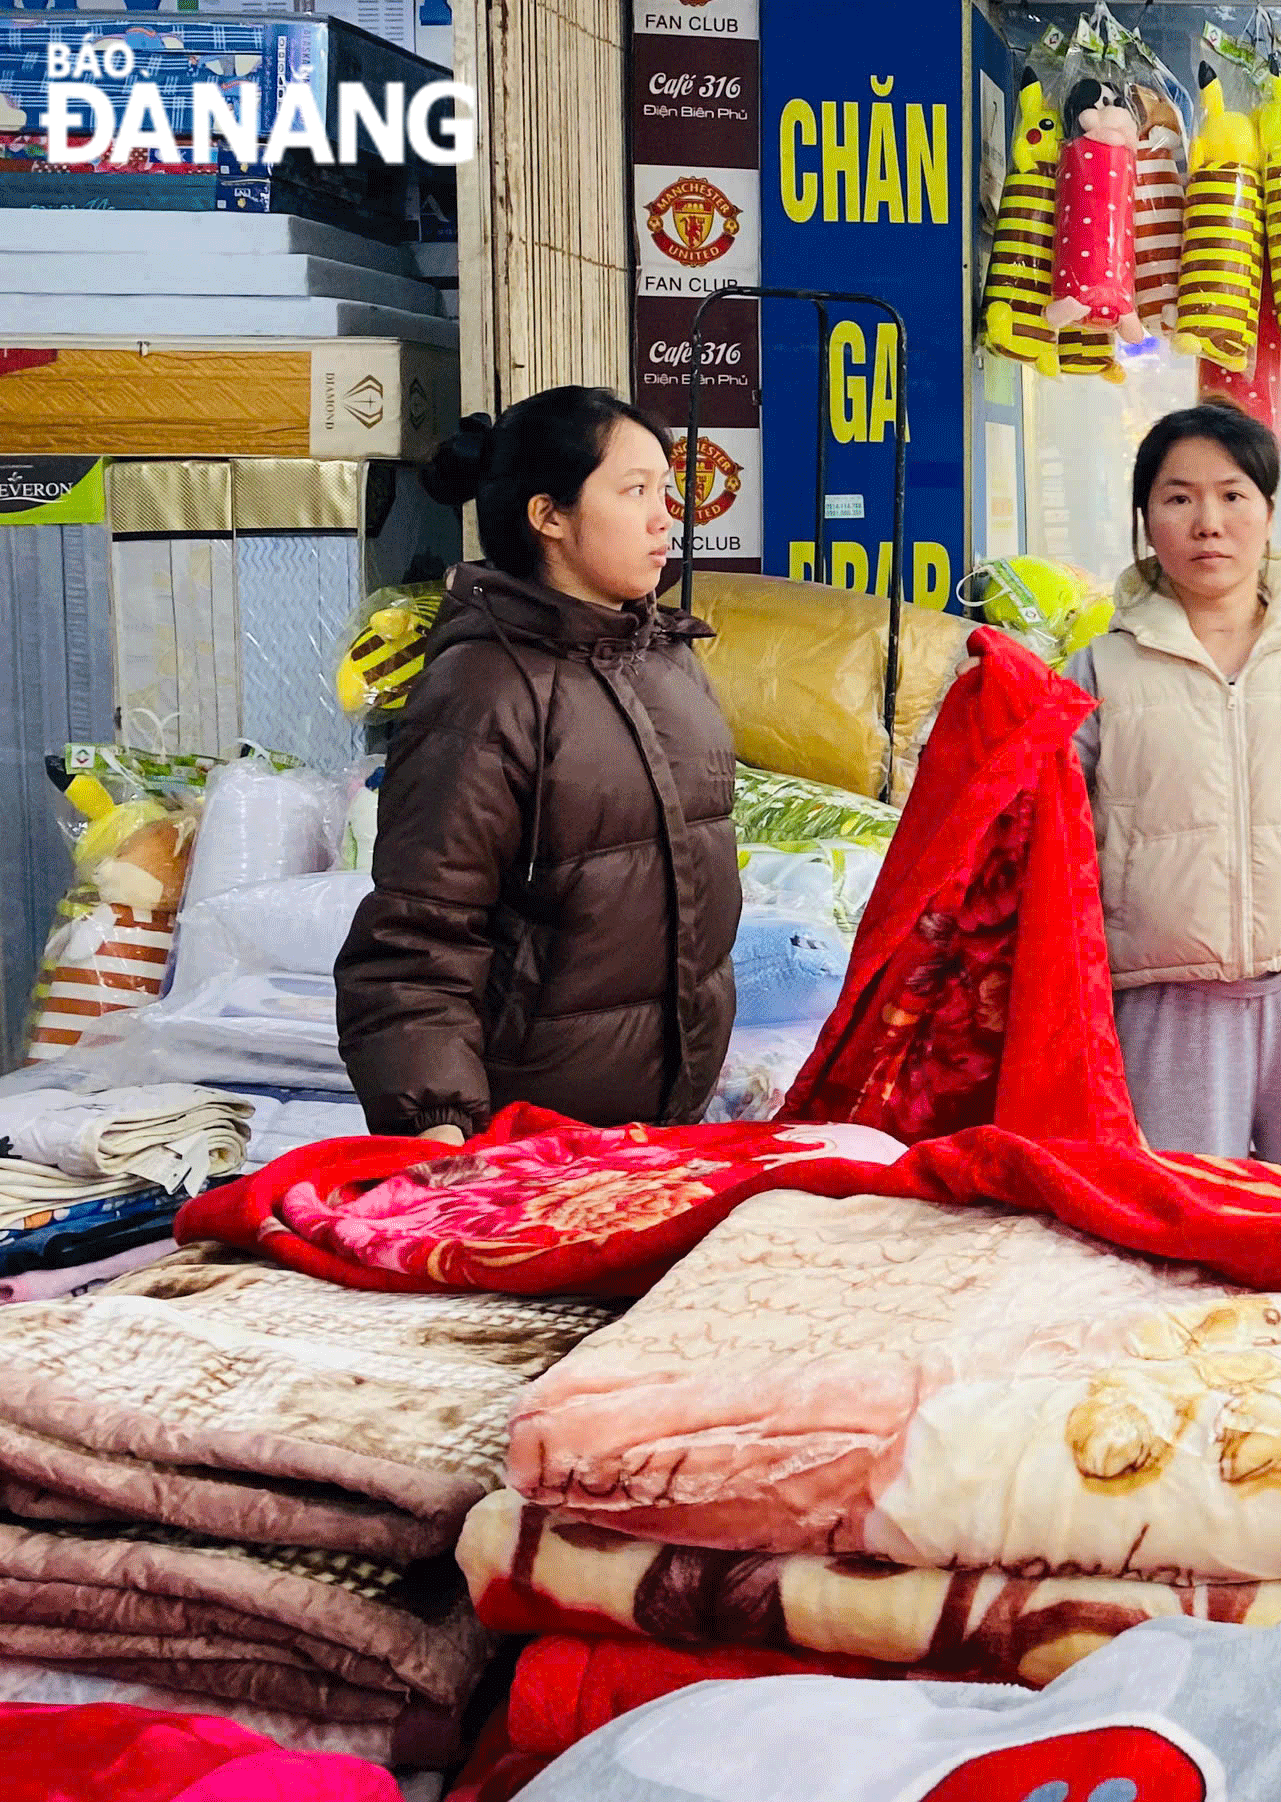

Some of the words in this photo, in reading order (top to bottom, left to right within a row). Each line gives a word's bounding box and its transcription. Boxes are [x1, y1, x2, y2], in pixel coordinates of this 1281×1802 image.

[645, 14, 682, 30] FAN
[688, 16, 739, 33] CLUB
[648, 72, 697, 99] Café
[698, 75, 742, 99] 316
[643, 104, 678, 119] Điện
[680, 106, 715, 119] Biên
[717, 109, 748, 121] Phủ
[779, 74, 949, 225] CHĂN
[656, 182, 731, 214] MANCHESTER
[668, 245, 720, 261] UNITED
[645, 276, 682, 291] FAN
[700, 342, 742, 365] 316
[643, 373, 679, 386] Điện
[717, 375, 748, 386] Phủ
[828, 320, 911, 444] GA
[325, 372, 335, 430] DIAMOND
[669, 504, 721, 519] UTED
[692, 536, 741, 551] CLUB
